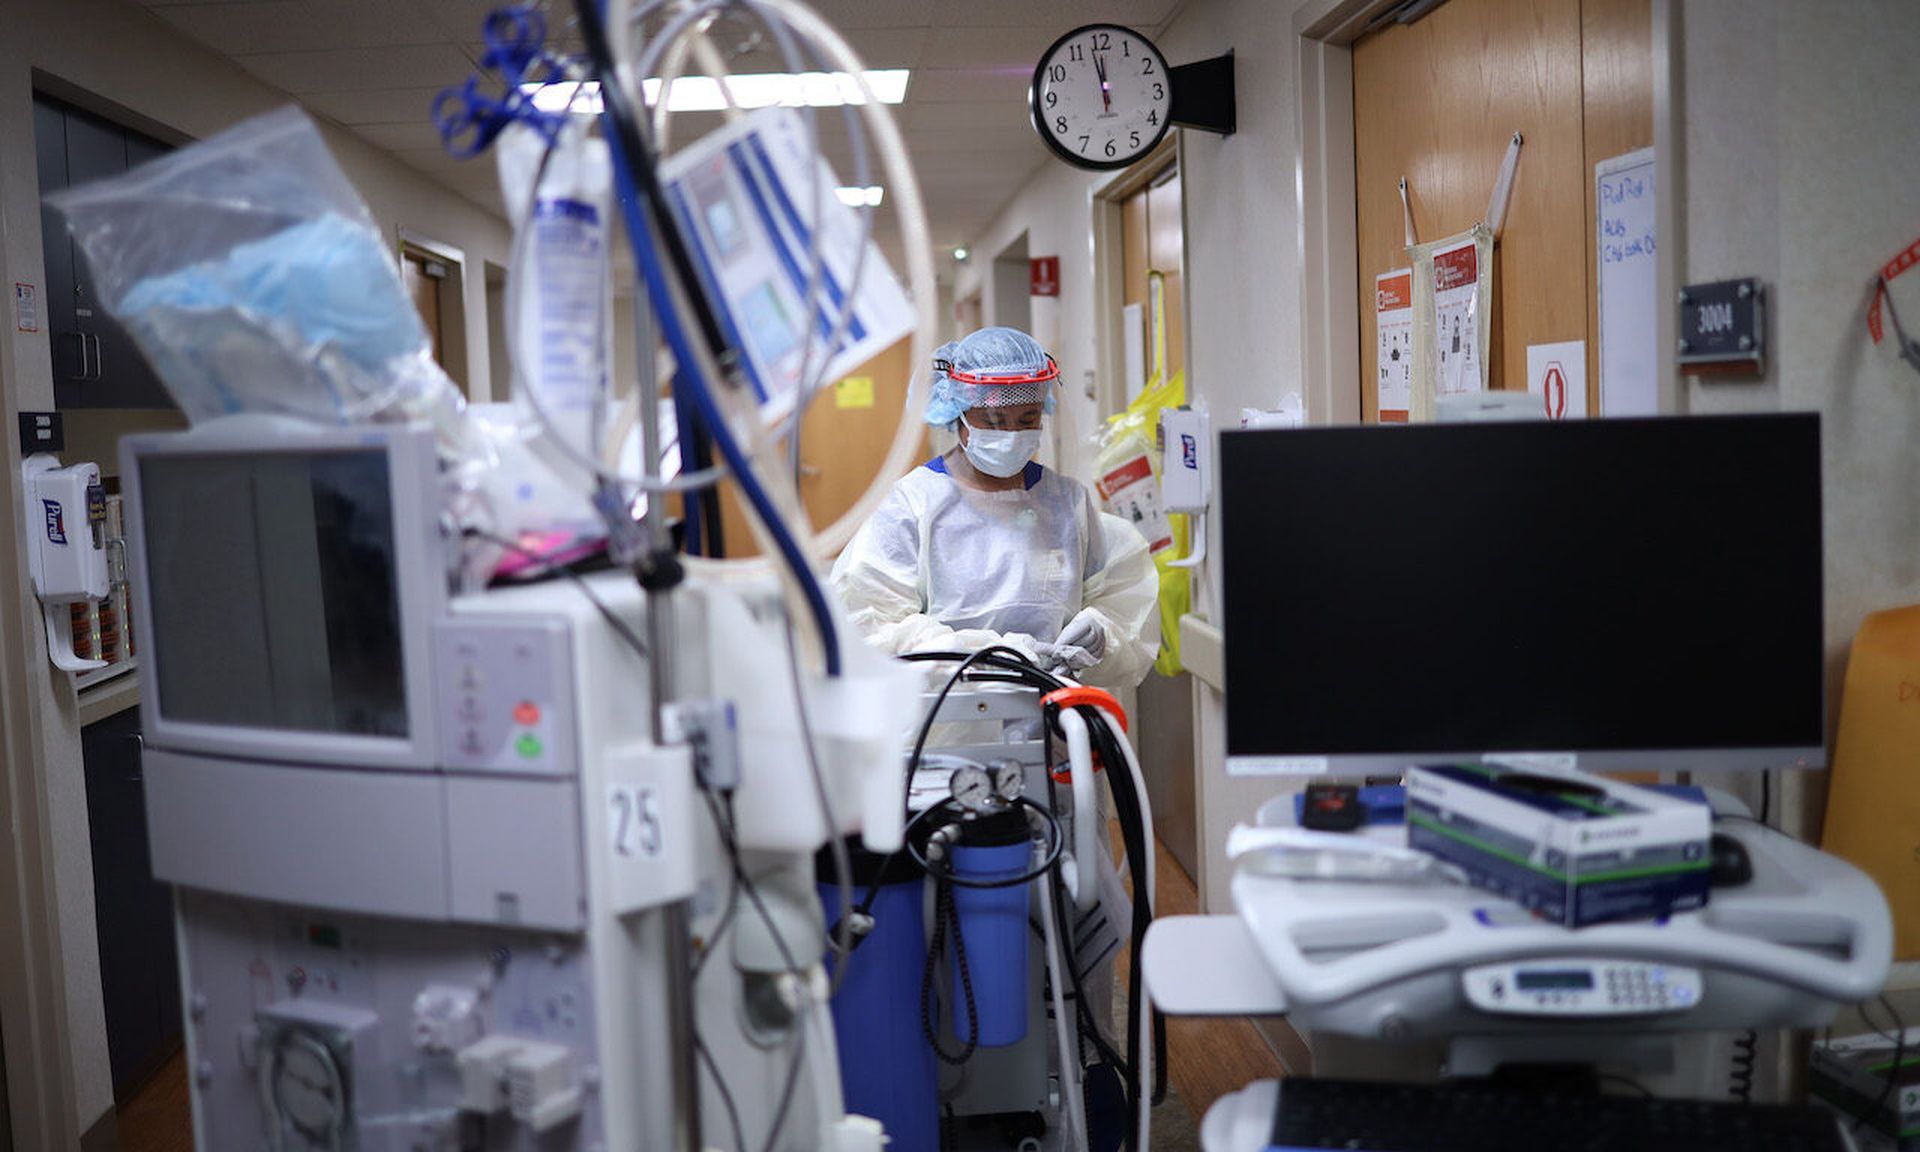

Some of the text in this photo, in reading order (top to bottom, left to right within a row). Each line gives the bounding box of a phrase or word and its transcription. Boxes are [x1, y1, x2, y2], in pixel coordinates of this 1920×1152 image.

[1092, 33, 1111, 51] 12
[1122, 41, 1130, 58] 1
[1069, 44, 1084, 62] 11
[1048, 65, 1066, 84] 10
[1142, 58, 1154, 75] 2
[1046, 91, 1058, 110] 9
[1152, 83, 1164, 101] 3
[1056, 116, 1068, 134] 8
[1147, 109, 1158, 126] 4
[1079, 135, 1090, 154] 7
[1105, 138, 1116, 157] 6
[1129, 131, 1141, 149] 5
[1697, 303, 1733, 334] 3004
[46, 503, 64, 543] Purell
[610, 788, 662, 857] 25
